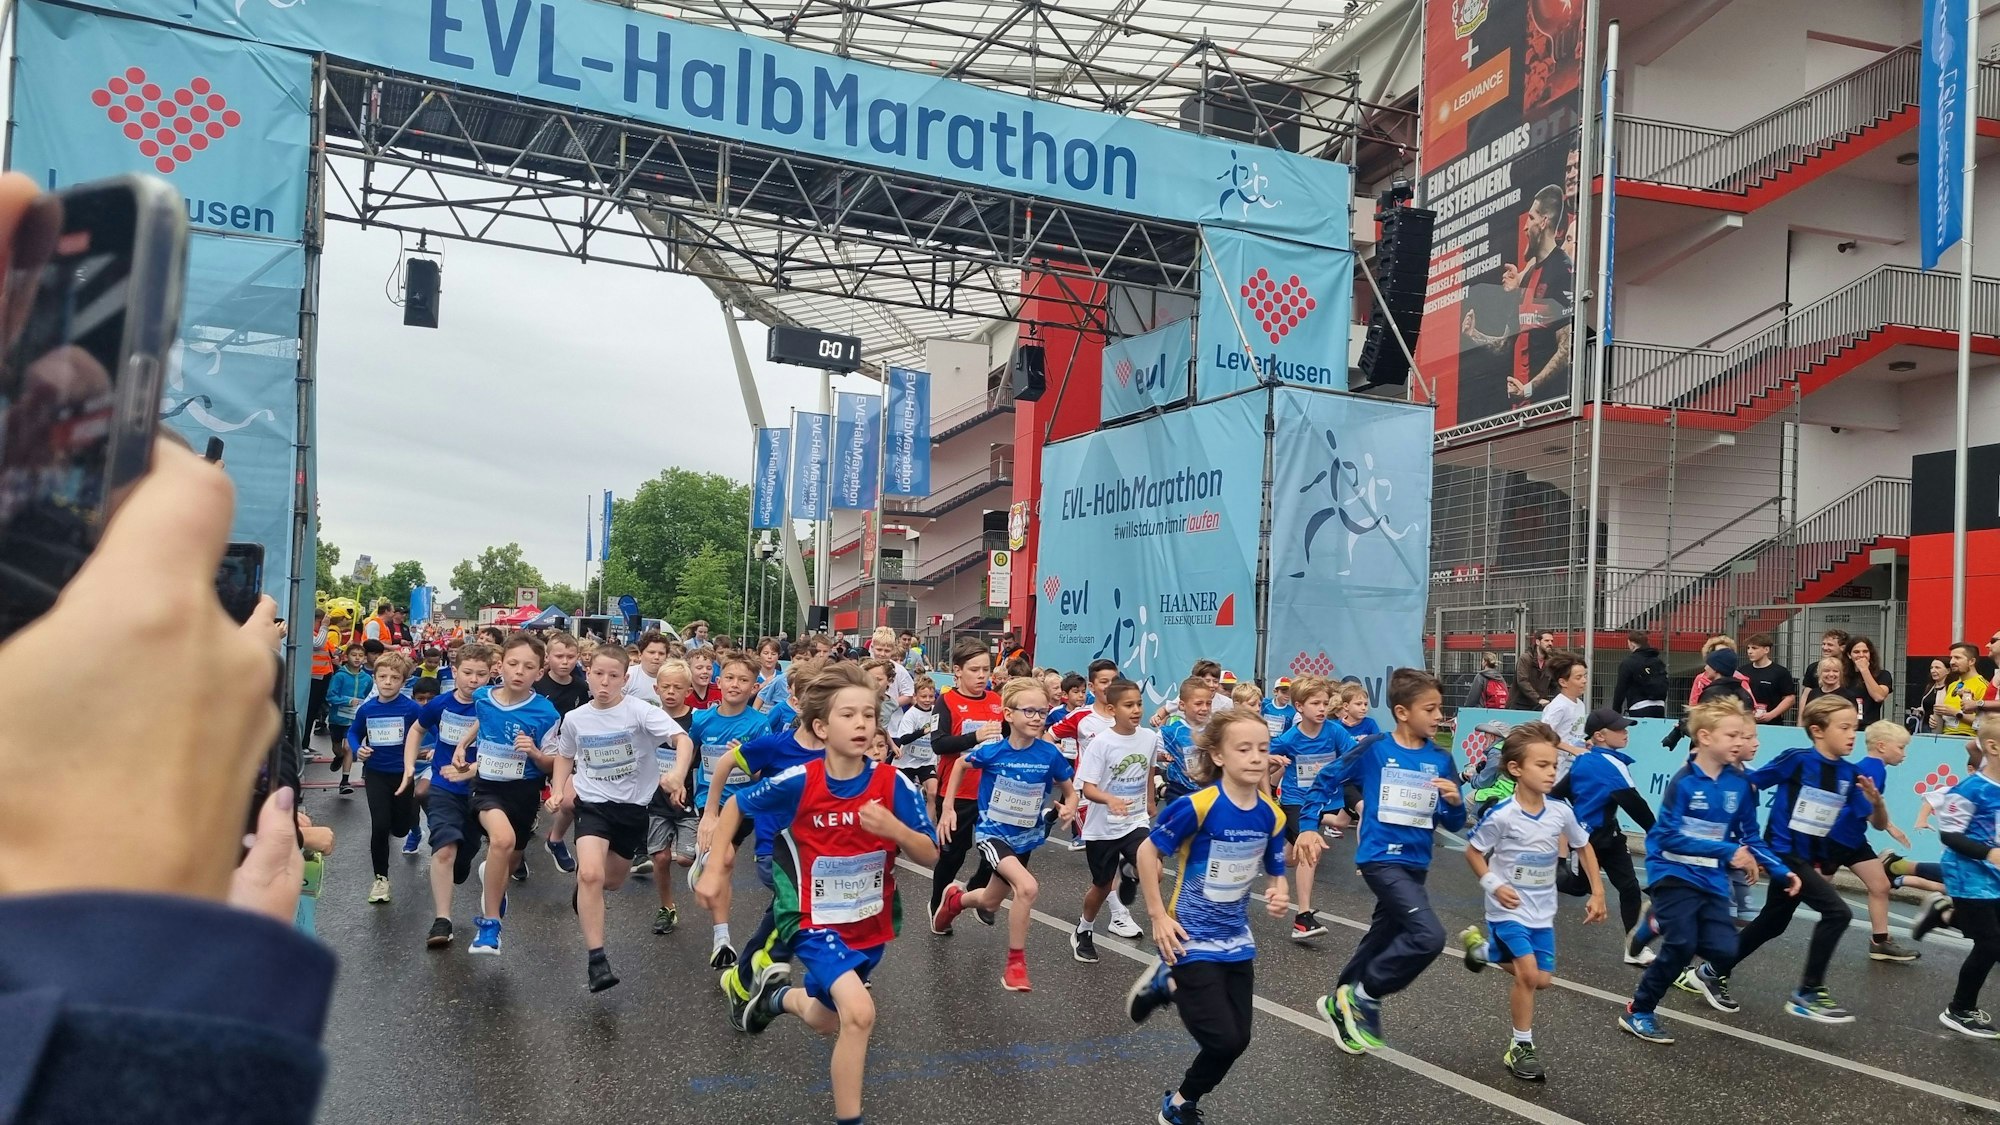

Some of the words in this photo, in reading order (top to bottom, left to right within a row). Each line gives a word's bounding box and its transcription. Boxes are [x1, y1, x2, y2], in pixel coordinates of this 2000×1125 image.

[429, 0, 1137, 200] EVL-HalbMarathon
[1454, 70, 1504, 111] LEDVANCE
[1428, 169, 1446, 200] EIN
[1447, 123, 1530, 190] STRAHLENDES
[819, 339, 855, 360] 0:01
[1216, 344, 1331, 385] Leverkusen
[1135, 353, 1166, 395] evl
[902, 372, 916, 492] EVL-HalbMarathon
[808, 416, 822, 518] EVL-HalbMarathon
[850, 396, 866, 506] EVL-HalbMarathon
[763, 430, 780, 526] EVL-HalbMarathon
[1062, 466, 1223, 520] EVL-HalbMarathon
[1114, 510, 1220, 540] #willstdumitmirlaufen
[1060, 580, 1088, 615] evl
[1160, 592, 1218, 613] HAANER
[1059, 622, 1077, 632] Energie
[1164, 614, 1212, 627] FELSENQUELLE
[1067, 633, 1095, 644] Leverkusen
[485, 757, 513, 769] Gregor
[594, 748, 620, 758] Eliano
[1005, 795, 1031, 807] Jonas
[1400, 788, 1422, 800] Elias
[813, 812, 864, 828] KEN
